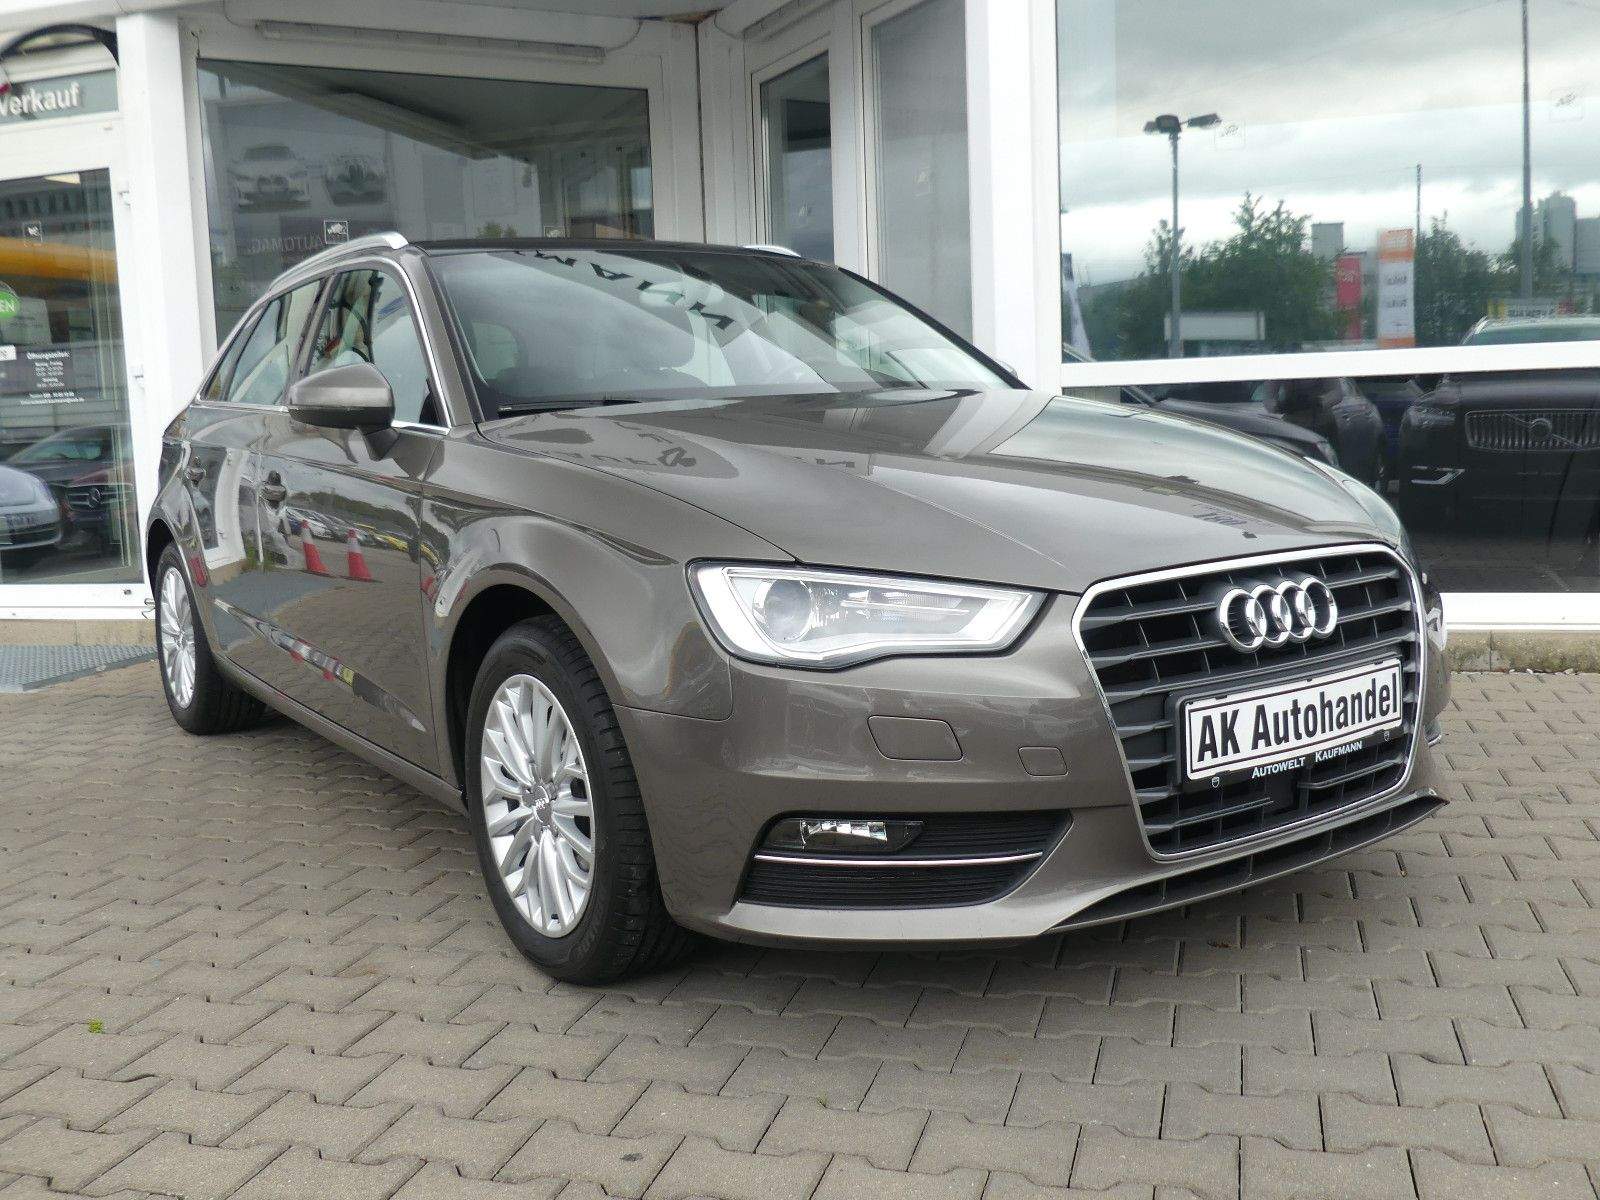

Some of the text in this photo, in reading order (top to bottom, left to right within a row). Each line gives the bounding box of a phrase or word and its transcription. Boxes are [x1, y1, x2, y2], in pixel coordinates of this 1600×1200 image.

[1197, 672, 1398, 763] AK Autohandel
[1251, 741, 1363, 779] AUTOWELT KAUFMANN
